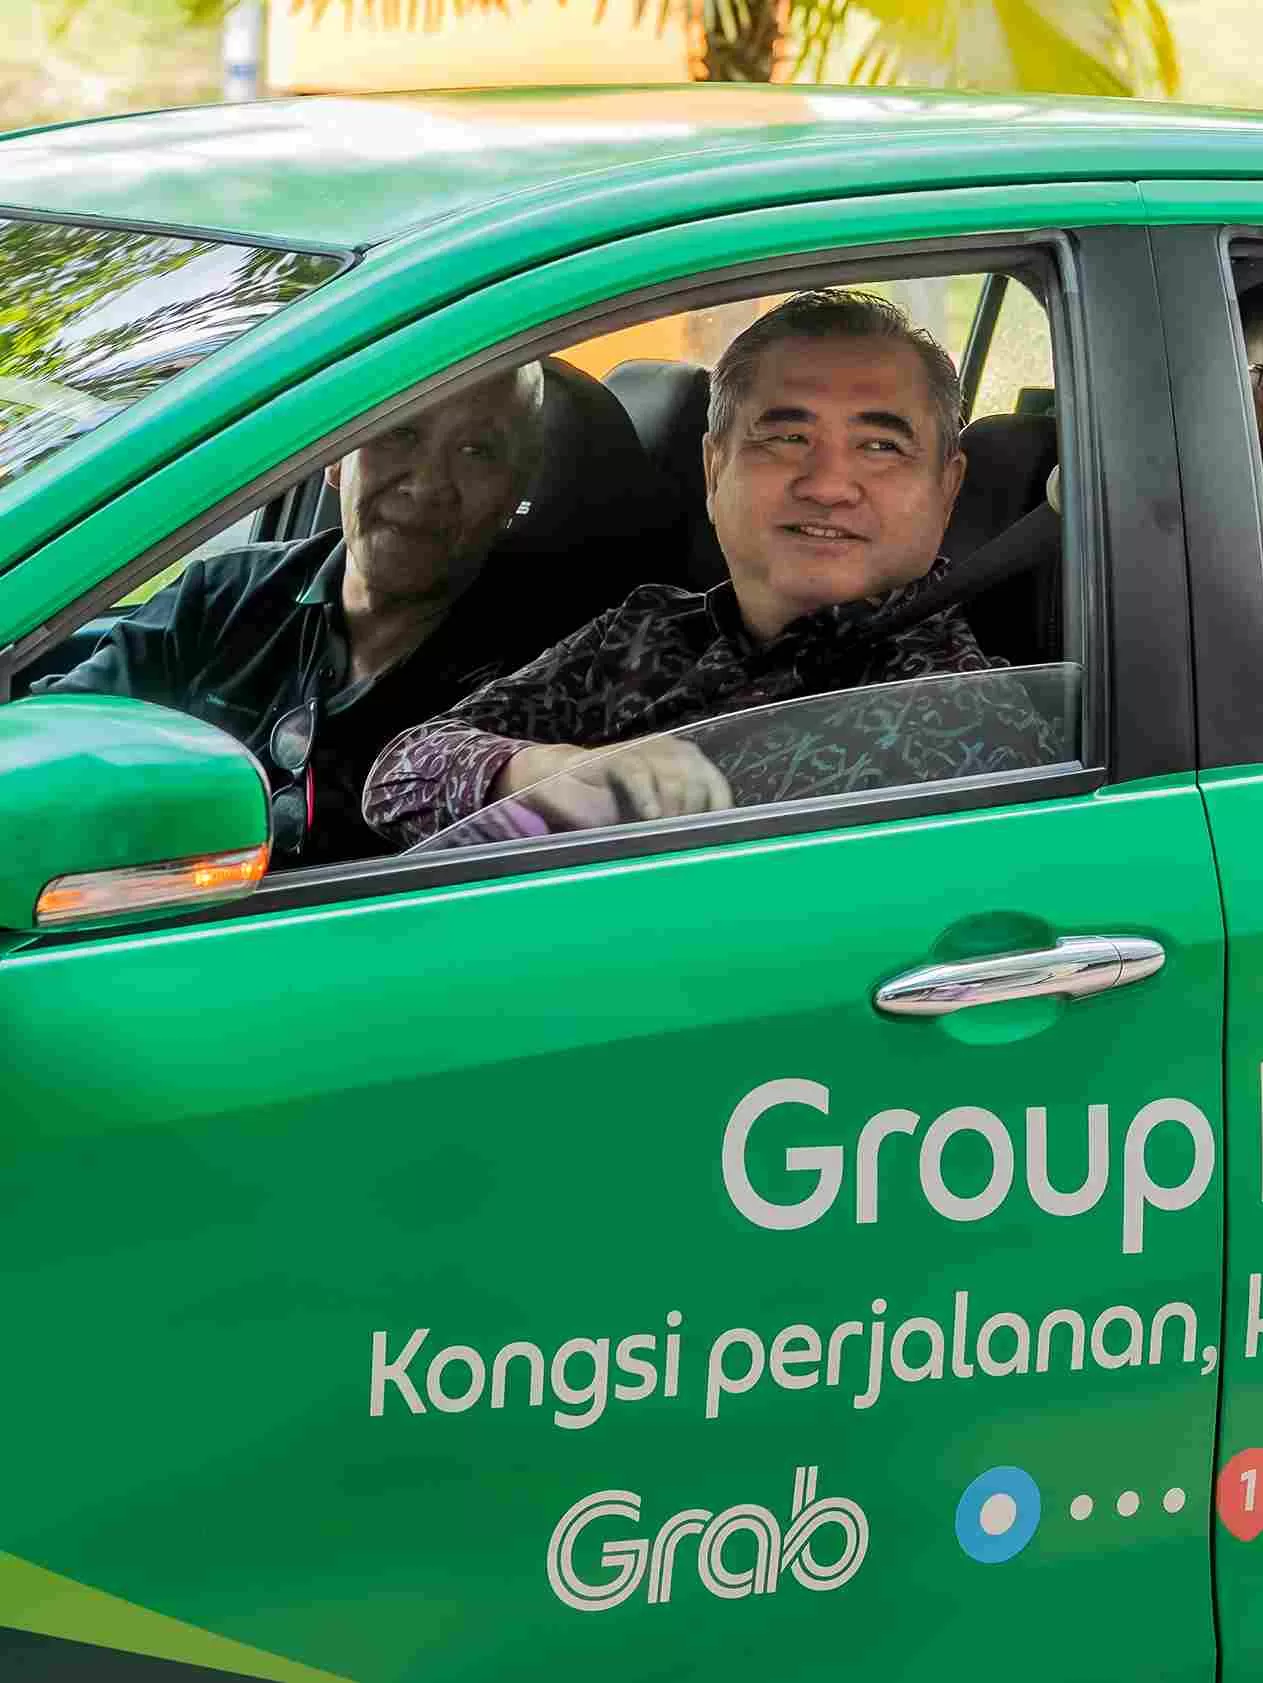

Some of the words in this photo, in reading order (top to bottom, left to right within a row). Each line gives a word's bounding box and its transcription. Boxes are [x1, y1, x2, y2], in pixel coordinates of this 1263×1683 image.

[721, 1077, 1216, 1255] Group
[369, 1310, 682, 1430] Kongsi
[704, 1290, 1219, 1420] perjalanan,
[546, 1465, 870, 1612] Grab
[1239, 1470, 1257, 1511] 1
